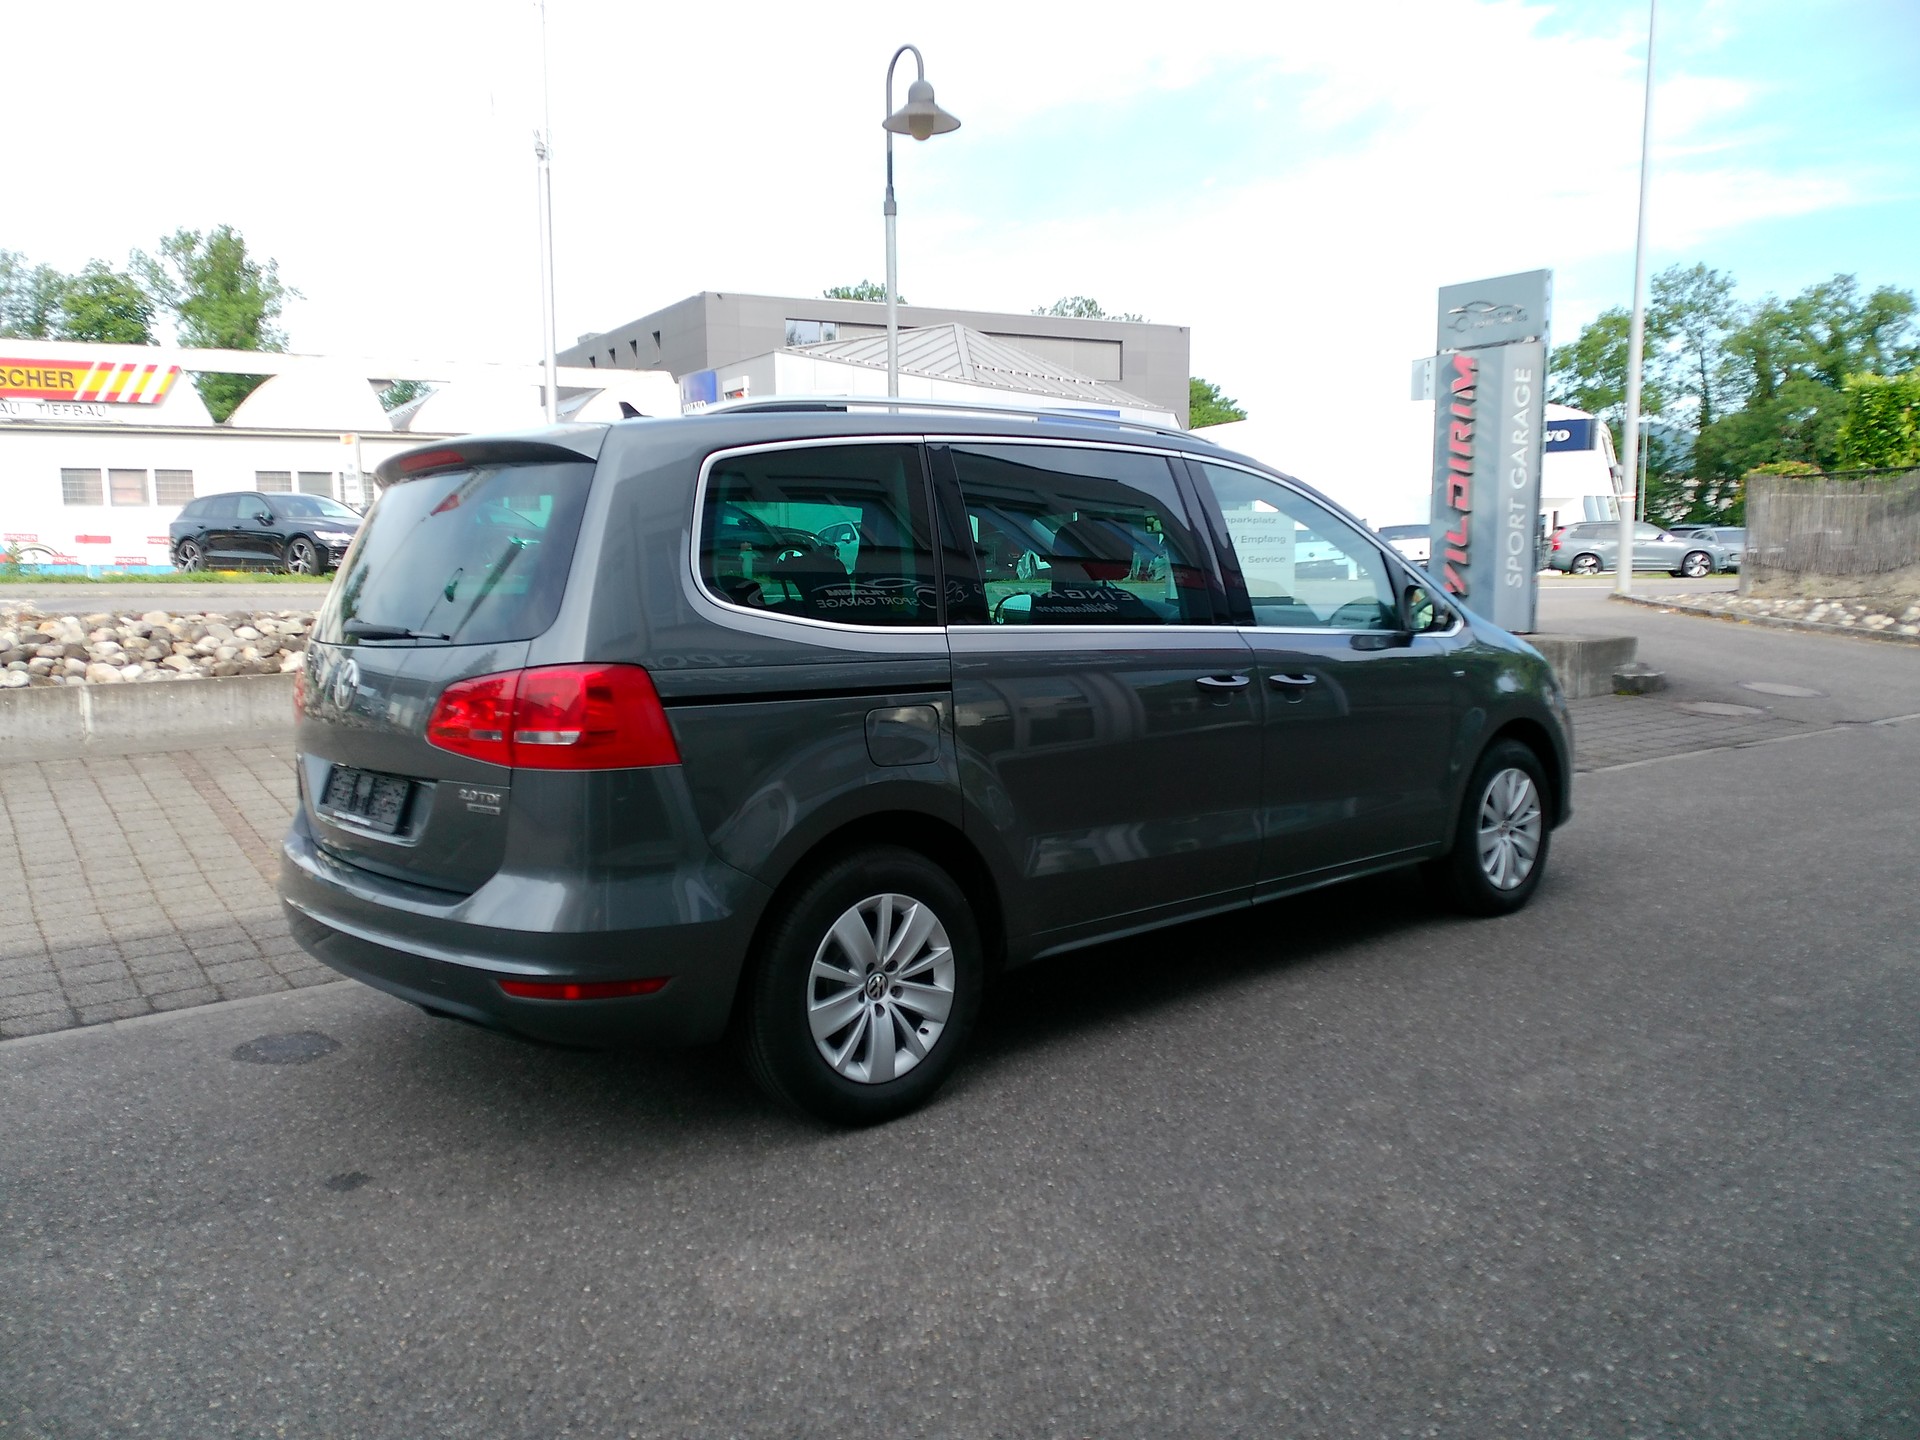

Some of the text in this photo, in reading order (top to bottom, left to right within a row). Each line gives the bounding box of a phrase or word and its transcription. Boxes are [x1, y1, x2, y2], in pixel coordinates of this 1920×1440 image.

[36, 403, 106, 417] TIEFBAU
[1506, 368, 1532, 588] SPORT GARAGE
[1241, 535, 1287, 545] Empfang
[1248, 556, 1287, 564] Service
